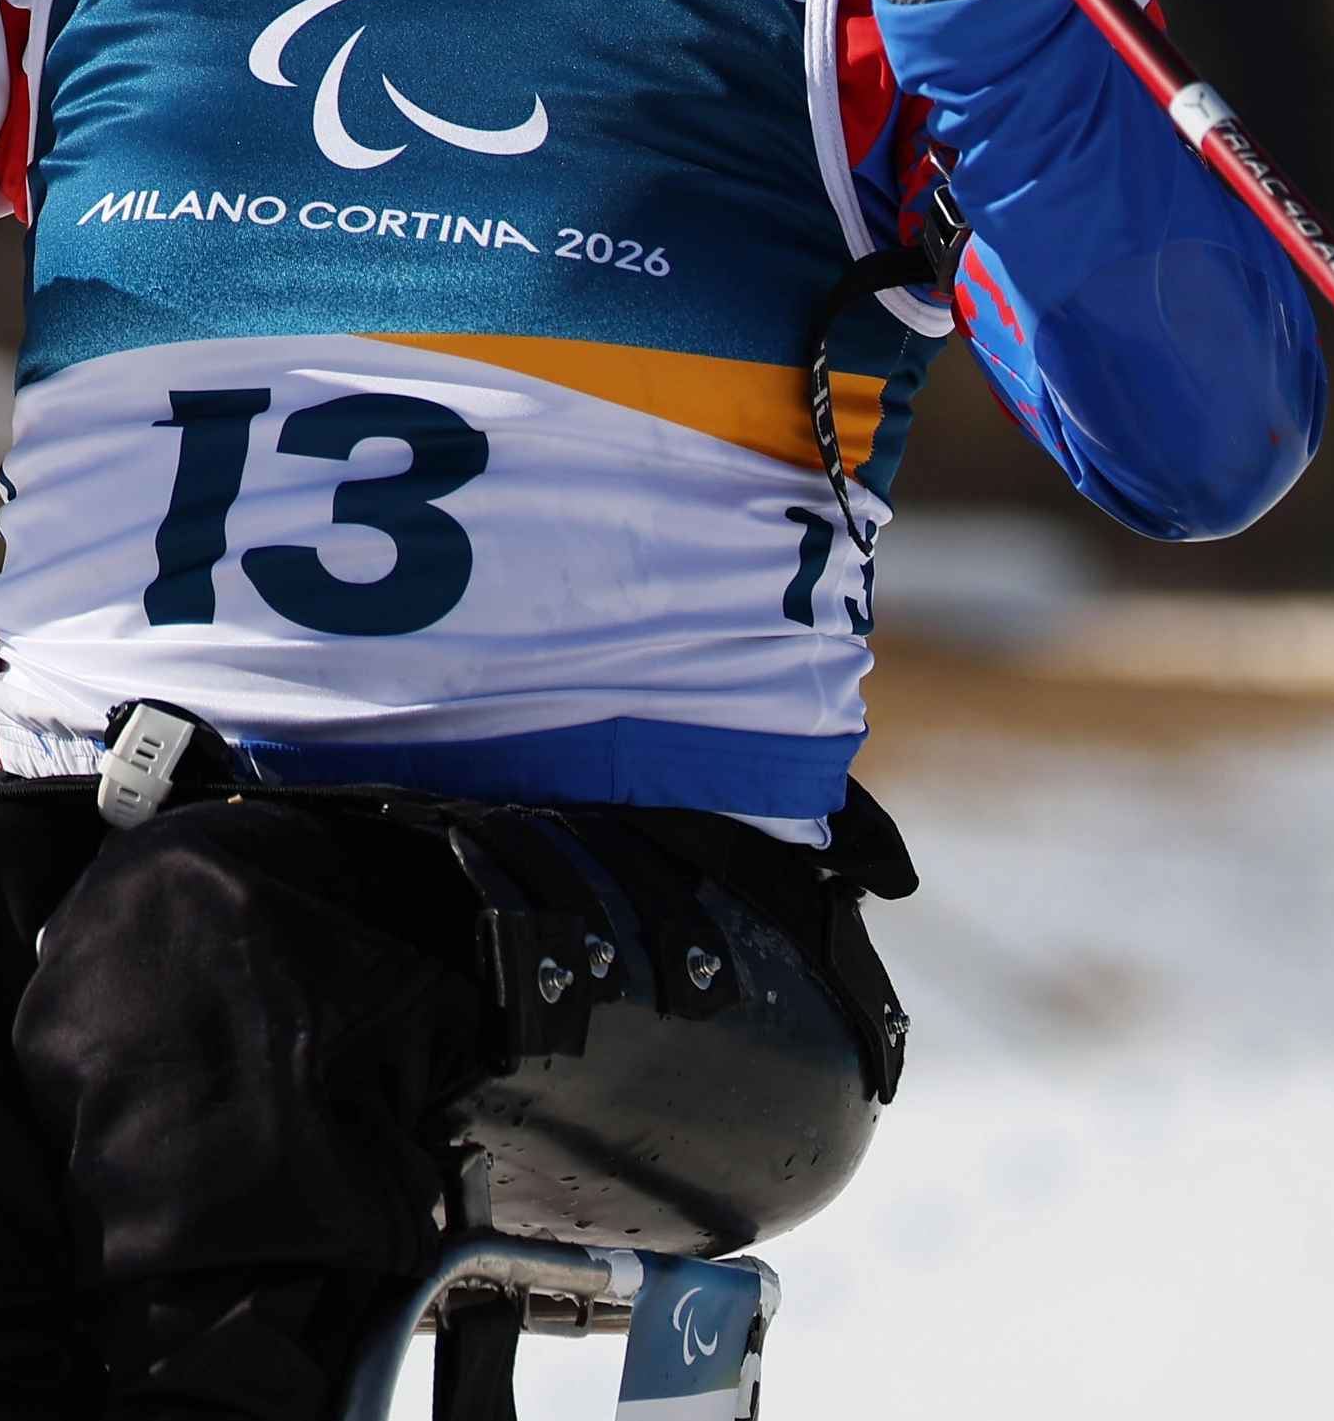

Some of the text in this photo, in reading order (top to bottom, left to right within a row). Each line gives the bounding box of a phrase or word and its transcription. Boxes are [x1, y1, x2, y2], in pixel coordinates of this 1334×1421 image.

[1217, 118, 1290, 197] TRIAC
[76, 189, 671, 278] MILANO CORTINA 2026
[143, 387, 490, 637] 13
